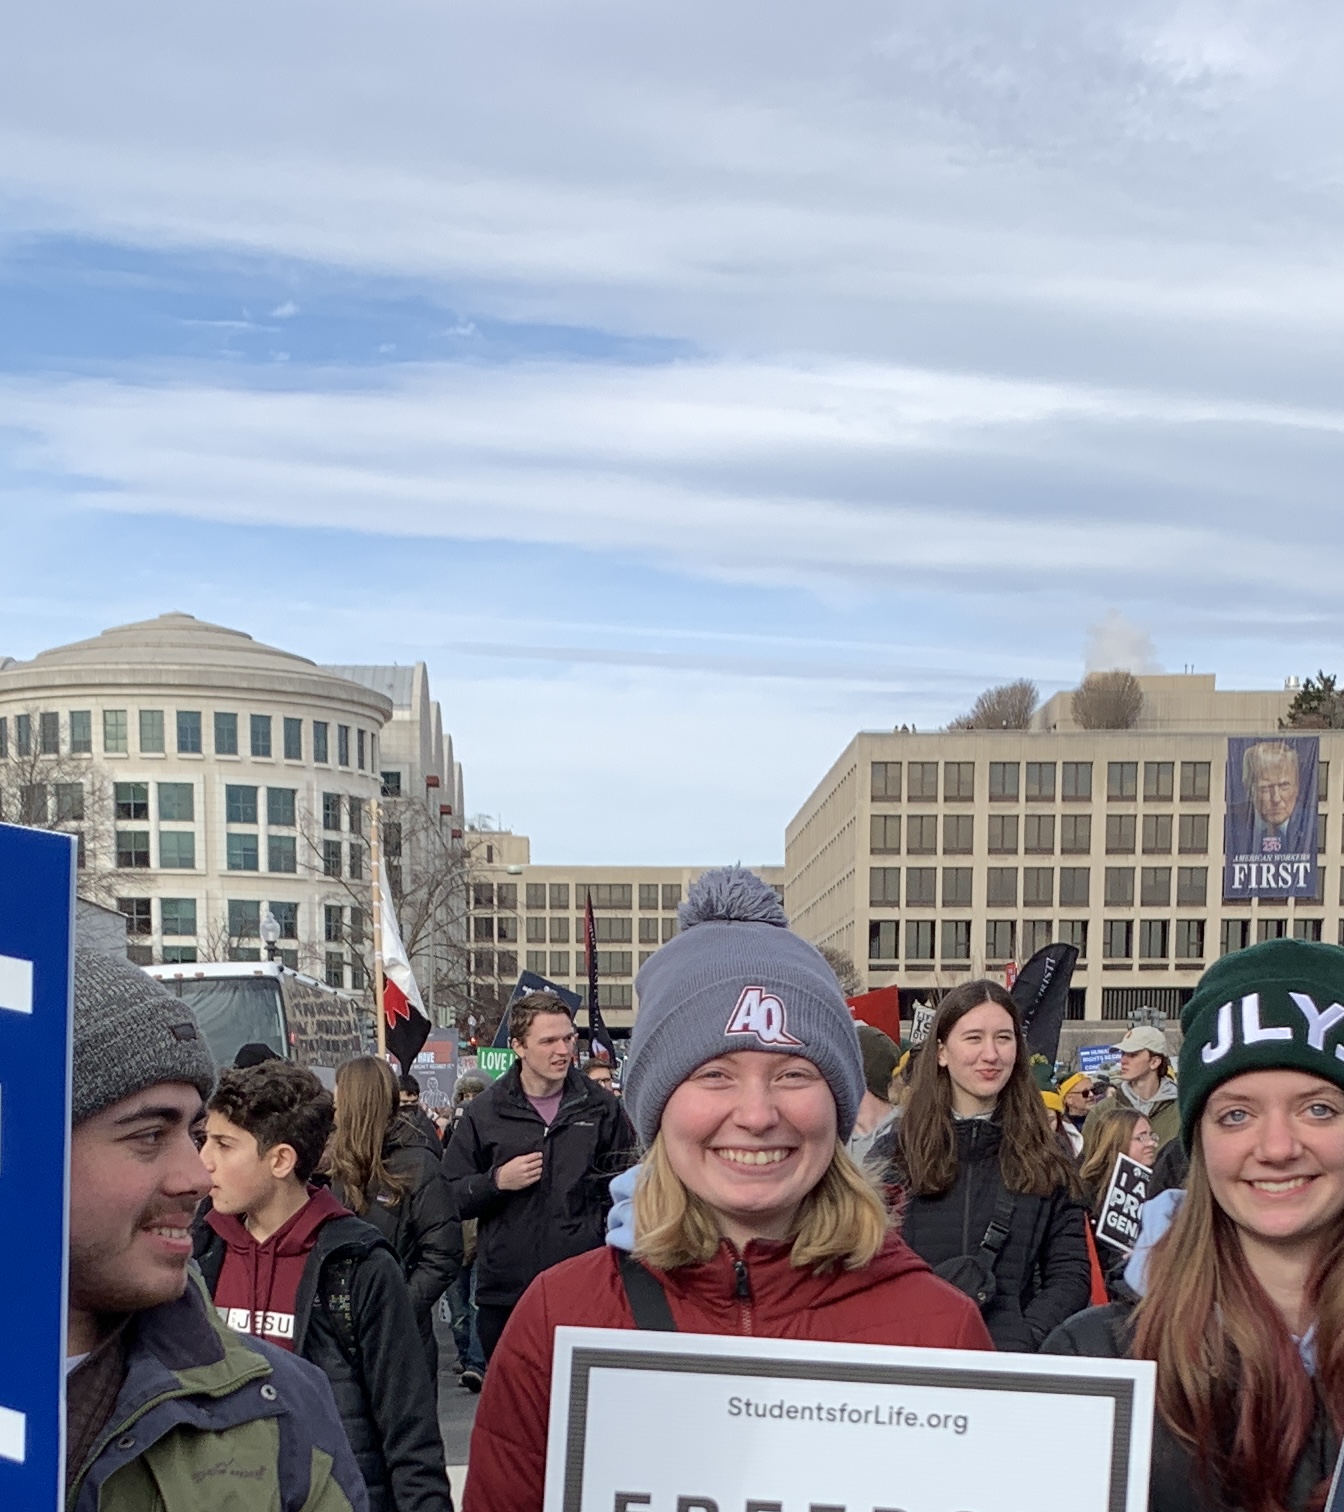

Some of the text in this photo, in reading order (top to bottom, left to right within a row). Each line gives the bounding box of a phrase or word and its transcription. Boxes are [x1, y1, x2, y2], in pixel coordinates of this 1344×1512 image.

[1233, 853, 1310, 862] AMERICAN WORKERS
[1232, 862, 1311, 889] FIRST
[724, 986, 805, 1047] AQ
[481, 1051, 507, 1070] LOVE
[1110, 1187, 1143, 1220] PR
[727, 1396, 969, 1435] StudentsforLife.org
